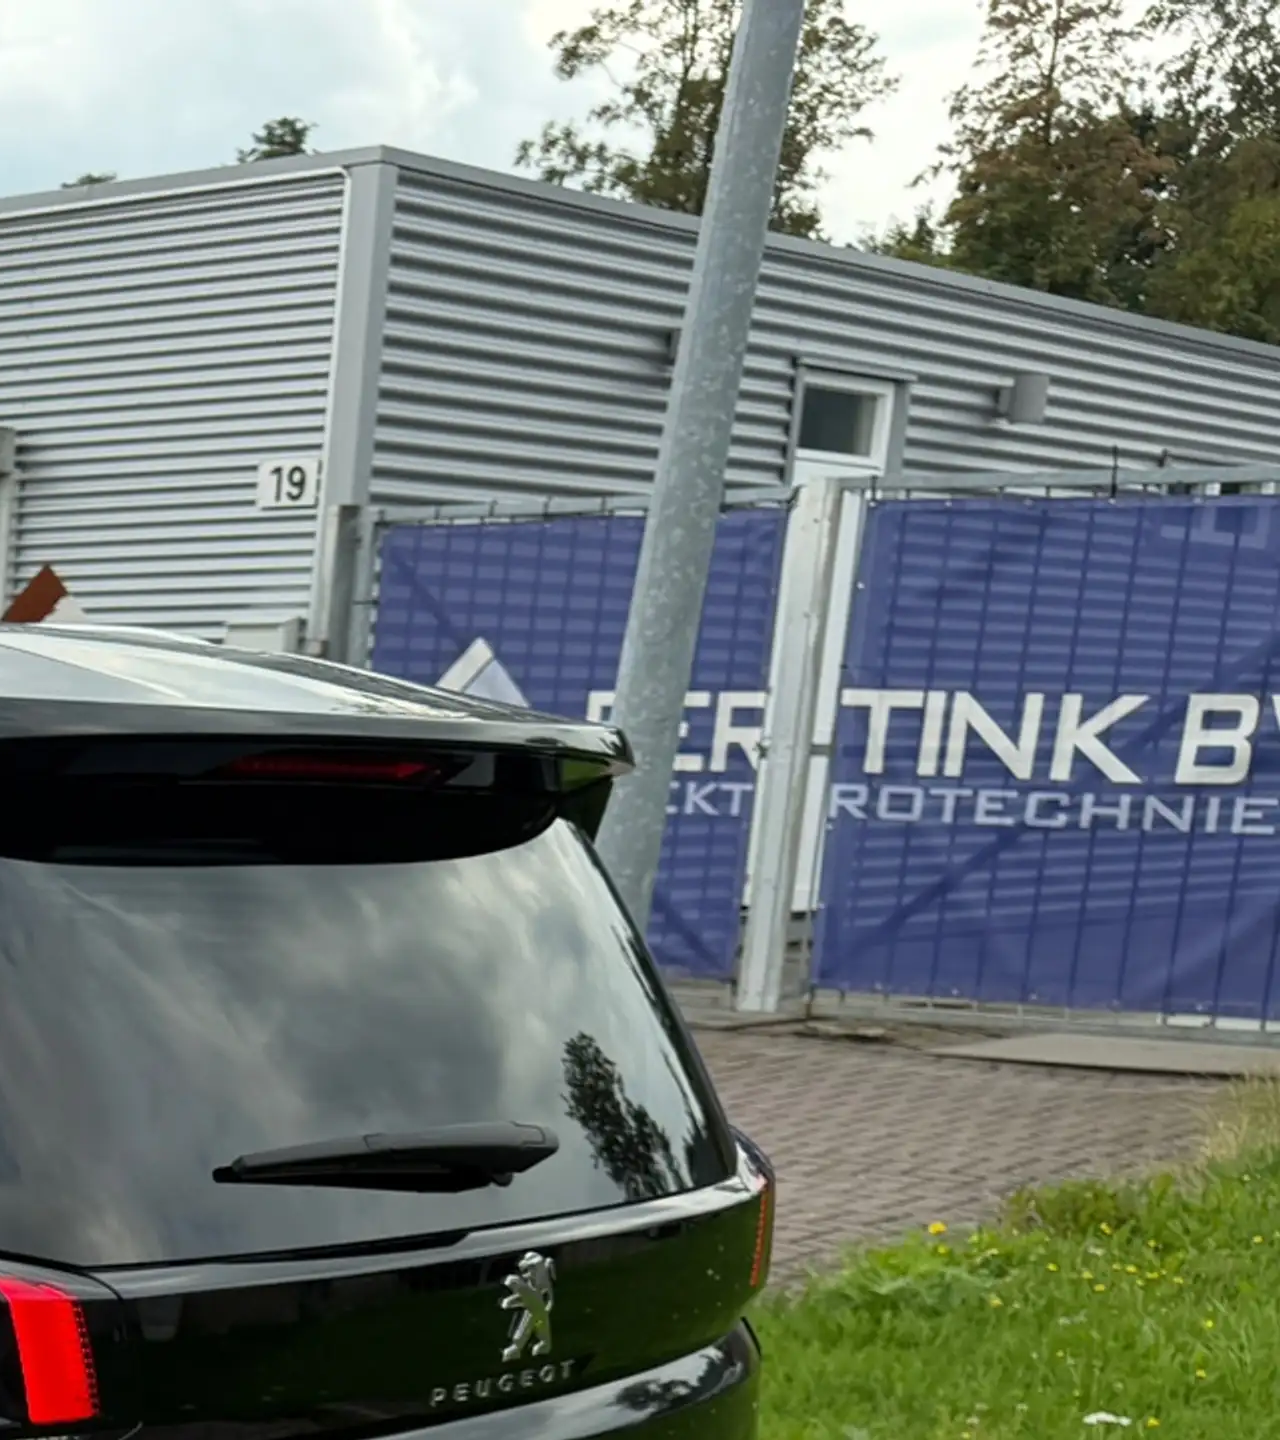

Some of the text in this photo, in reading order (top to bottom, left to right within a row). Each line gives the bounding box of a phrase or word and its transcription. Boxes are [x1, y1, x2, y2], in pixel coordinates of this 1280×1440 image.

[269, 465, 307, 502] 19
[1173, 693, 1280, 785] B
[429, 1359, 576, 1408] PEUGEOT
